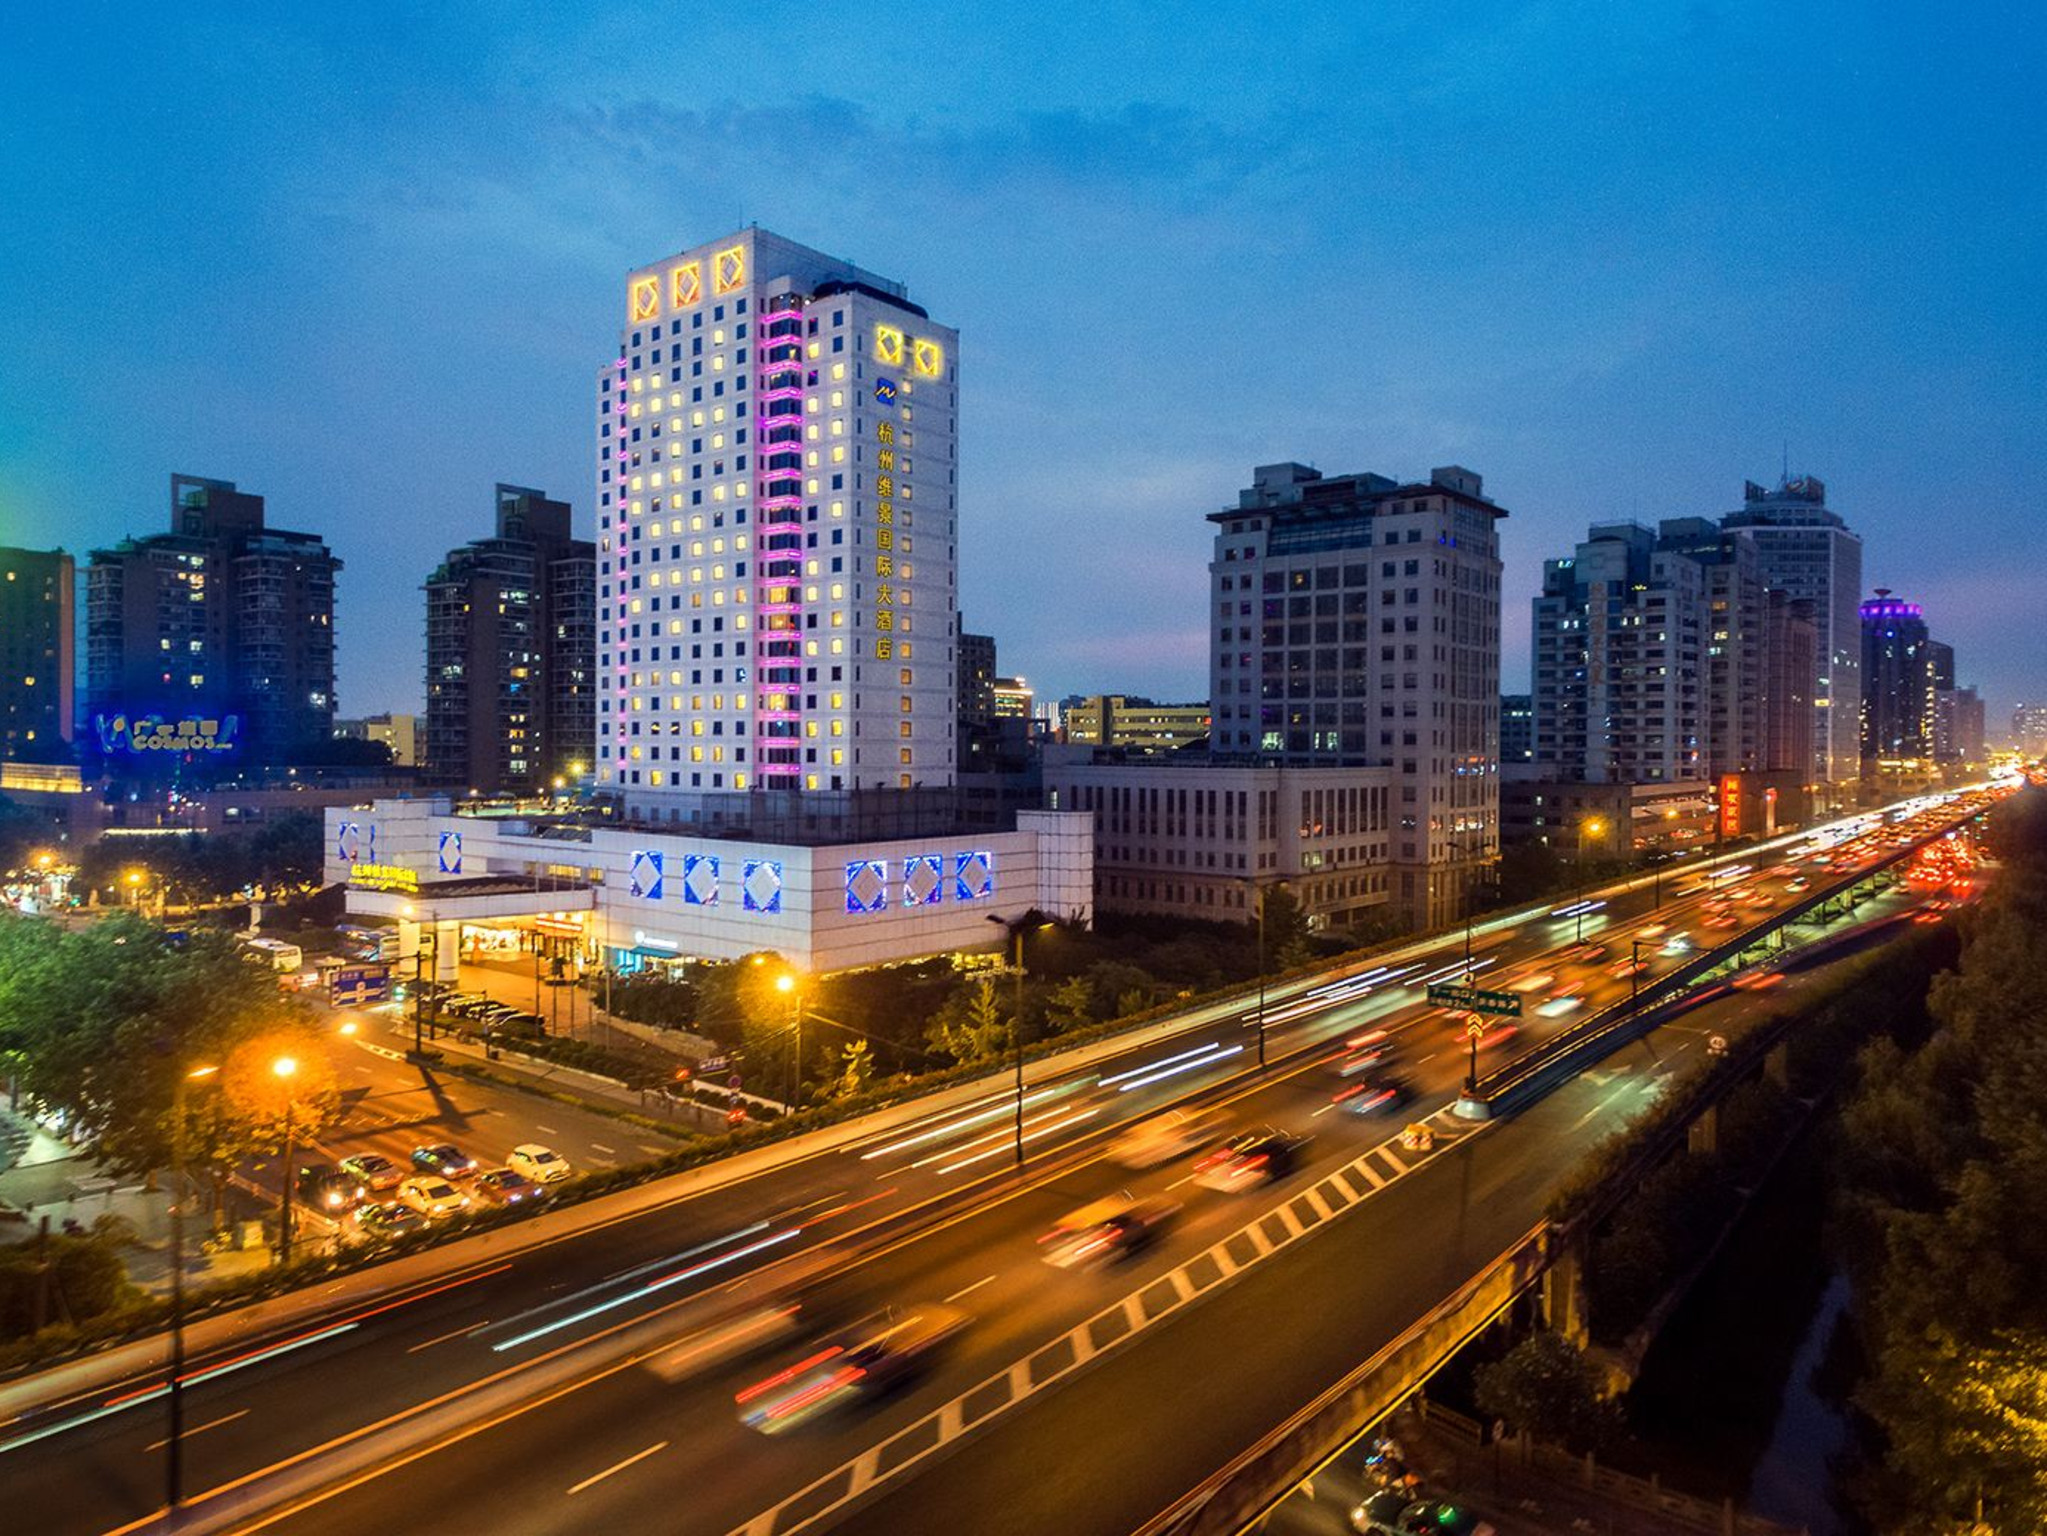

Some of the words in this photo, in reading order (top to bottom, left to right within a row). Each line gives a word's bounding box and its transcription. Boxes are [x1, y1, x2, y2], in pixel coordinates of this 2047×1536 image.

[875, 421, 894, 661] 杭州维景国际大酒店
